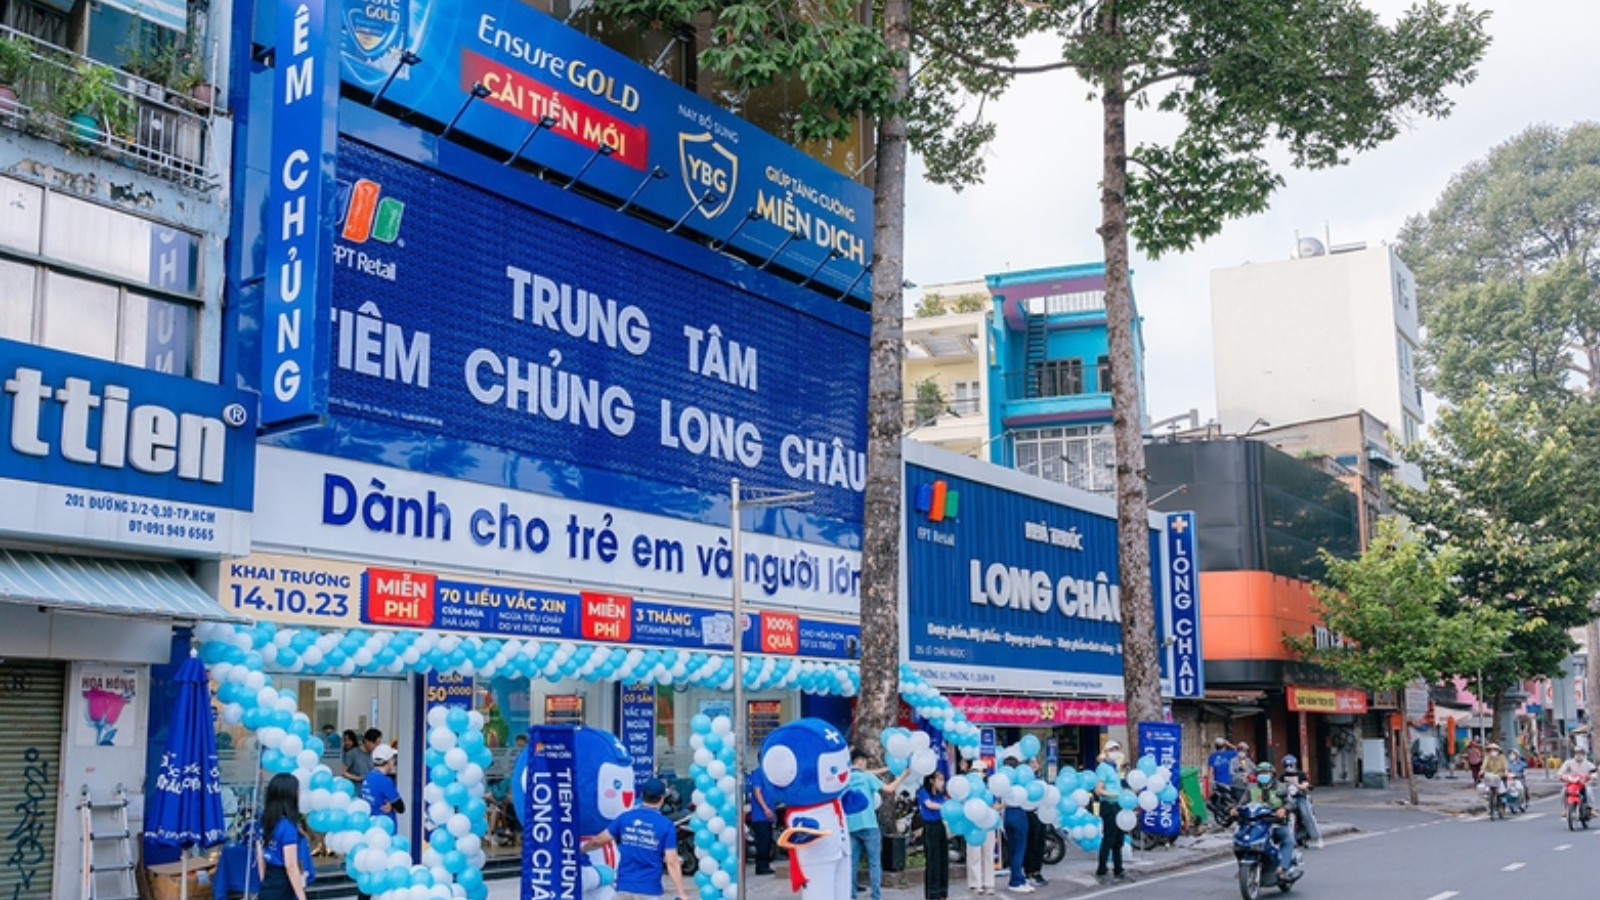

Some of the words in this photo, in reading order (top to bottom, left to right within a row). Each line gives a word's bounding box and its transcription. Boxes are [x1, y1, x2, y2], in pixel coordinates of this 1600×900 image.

[482, 71, 524, 111] CẢI
[528, 90, 578, 134] TIẾN
[583, 121, 626, 156] MỚI
[678, 103, 698, 122] NAY
[713, 121, 740, 144] SUNG
[687, 153, 728, 194] YBG
[756, 189, 811, 240] MIỄN
[815, 218, 865, 265] DỊCH
[273, 148, 309, 401] CHỦNG
[356, 251, 397, 282] Retail
[506, 265, 652, 356] TRUNG
[683, 323, 758, 391] TÂM
[4, 366, 227, 484] ttien
[463, 348, 636, 437] CHỦNG
[660, 398, 763, 468] LONG
[779, 434, 867, 493] CHÂU
[65, 493, 85, 508] 201
[166, 525, 186, 538] 949
[187, 527, 215, 542] 6565
[321, 472, 451, 542] Dành
[469, 501, 551, 554] cho
[566, 512, 619, 564] trẻ
[631, 532, 685, 574] em
[696, 536, 734, 580] và
[743, 549, 820, 596] người
[230, 564, 275, 581] KHAI
[280, 568, 351, 589] TRƯƠNG
[376, 572, 427, 599] MIỄN
[969, 558, 1053, 614] LONG
[1172, 538, 1193, 610] LONG
[230, 583, 349, 618] 14.10.23
[384, 598, 420, 620] PHÍ
[439, 587, 461, 604] 70
[540, 598, 567, 614] XIN
[587, 597, 626, 620] MIỄN
[635, 608, 644, 622] 3
[646, 608, 693, 626] THÁNG
[593, 620, 620, 639] PHÍ
[765, 616, 795, 632] 100%
[767, 633, 794, 650] QUÀ
[1175, 618, 1195, 696] CHÂU
[532, 771, 553, 844] LONG
[556, 767, 574, 823] TIÊM
